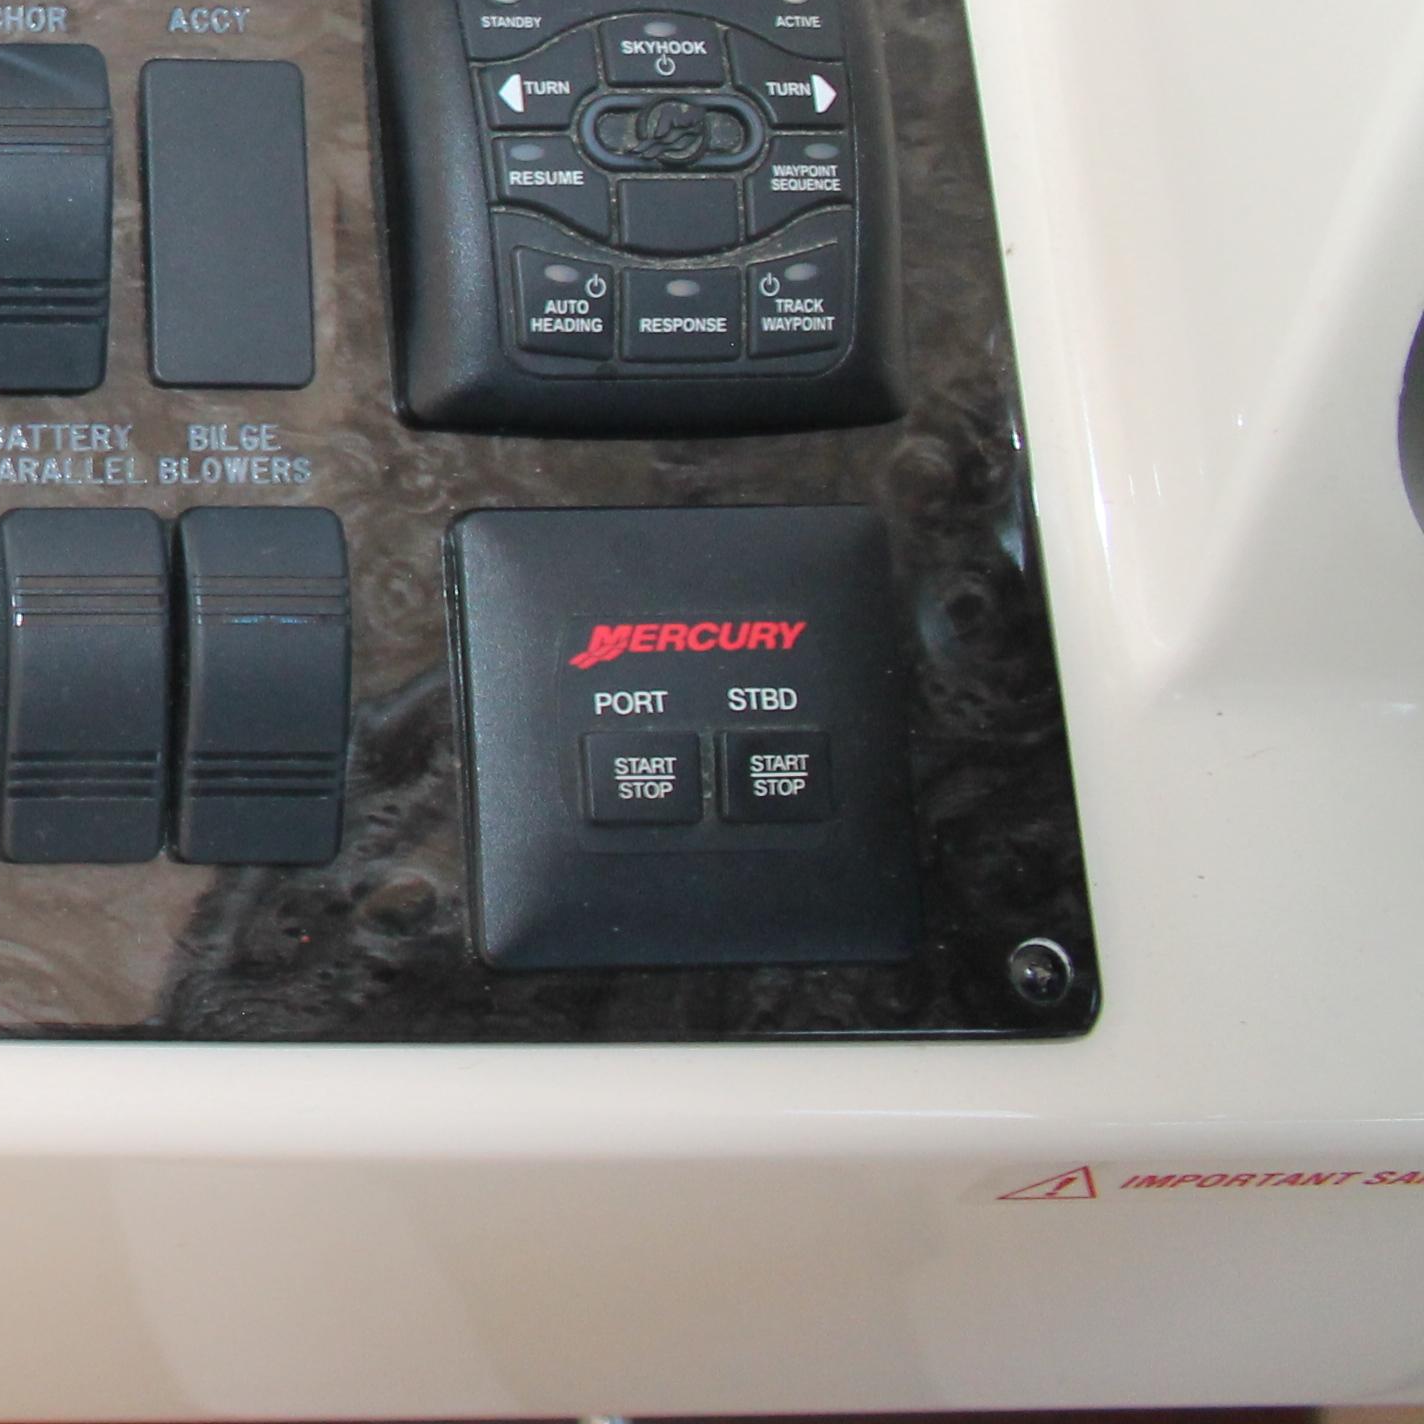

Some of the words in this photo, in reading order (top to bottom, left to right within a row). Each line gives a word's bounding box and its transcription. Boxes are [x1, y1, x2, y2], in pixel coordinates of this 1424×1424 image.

[167, 6, 250, 34] ACCY
[481, 16, 541, 29] STANDBY
[776, 15, 821, 29] ACTIVE
[621, 40, 707, 56] SKYHOOK
[524, 80, 570, 96] TURN
[767, 81, 811, 97] TURN
[510, 171, 584, 186] RESUME
[772, 165, 838, 178] WAYPOINT
[771, 178, 842, 192] SEQUENCE
[545, 299, 589, 315] AUTO
[775, 298, 825, 314] TRACK
[531, 317, 604, 334] HEADING
[640, 317, 728, 333] RESPONSE
[762, 316, 836, 333] WAYPOINT
[187, 423, 282, 453] BILGE
[159, 457, 312, 486] BLOWERS
[569, 621, 807, 669] MERCURY
[594, 690, 668, 715] PORT
[728, 687, 797, 711] STBD
[614, 756, 676, 775] START
[750, 753, 809, 772] START
[618, 781, 673, 799] STOP
[753, 778, 806, 796] STOP
[1119, 1171, 1363, 1189] IMPORTANT
